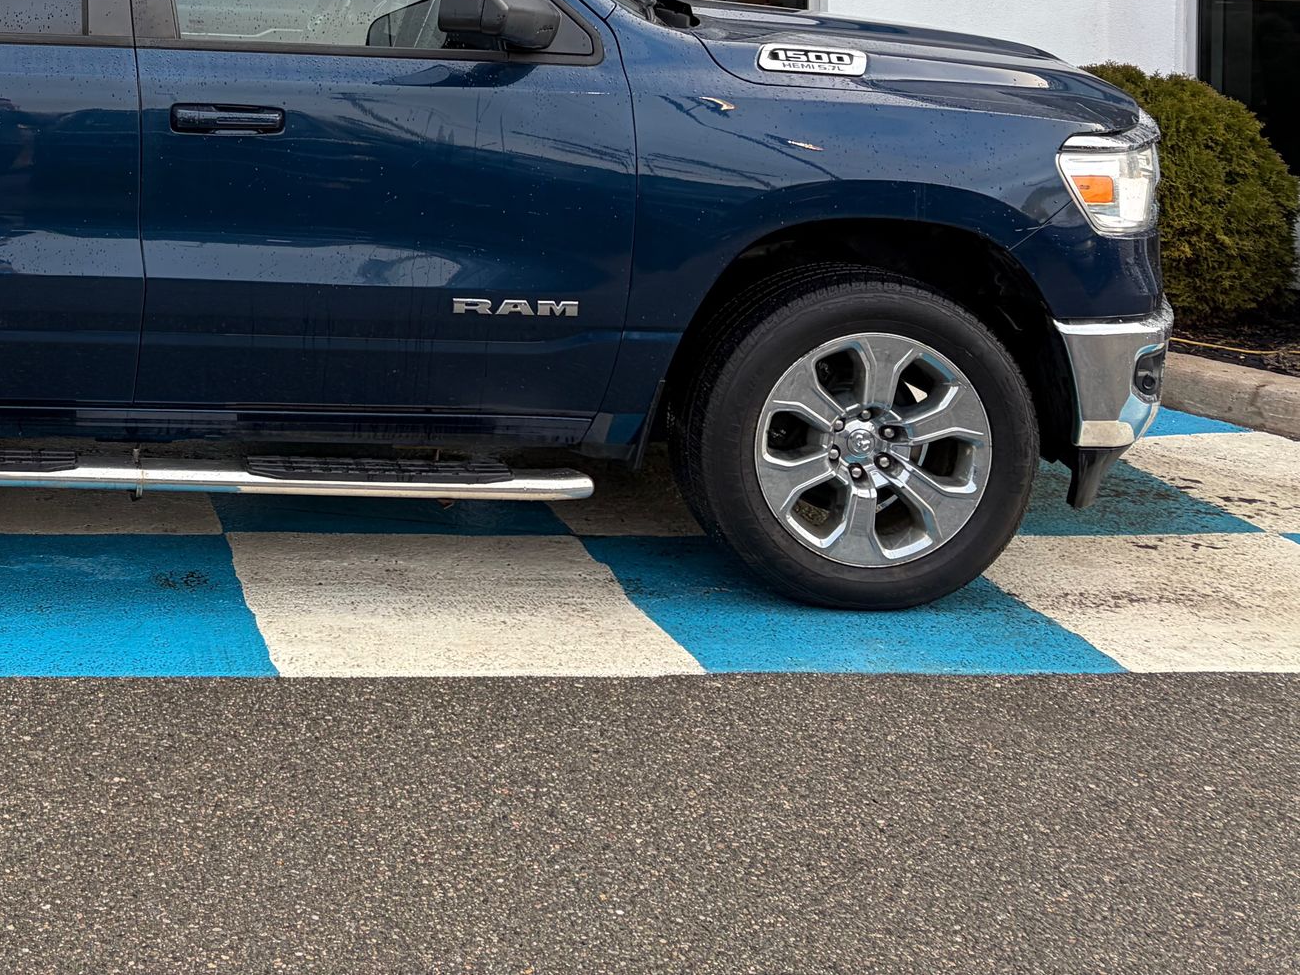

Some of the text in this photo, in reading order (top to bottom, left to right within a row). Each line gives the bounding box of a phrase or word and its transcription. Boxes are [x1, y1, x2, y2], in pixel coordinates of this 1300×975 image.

[773, 49, 852, 65] 1500
[782, 62, 845, 72] HEMI 5.7L
[452, 297, 580, 317] RAM
